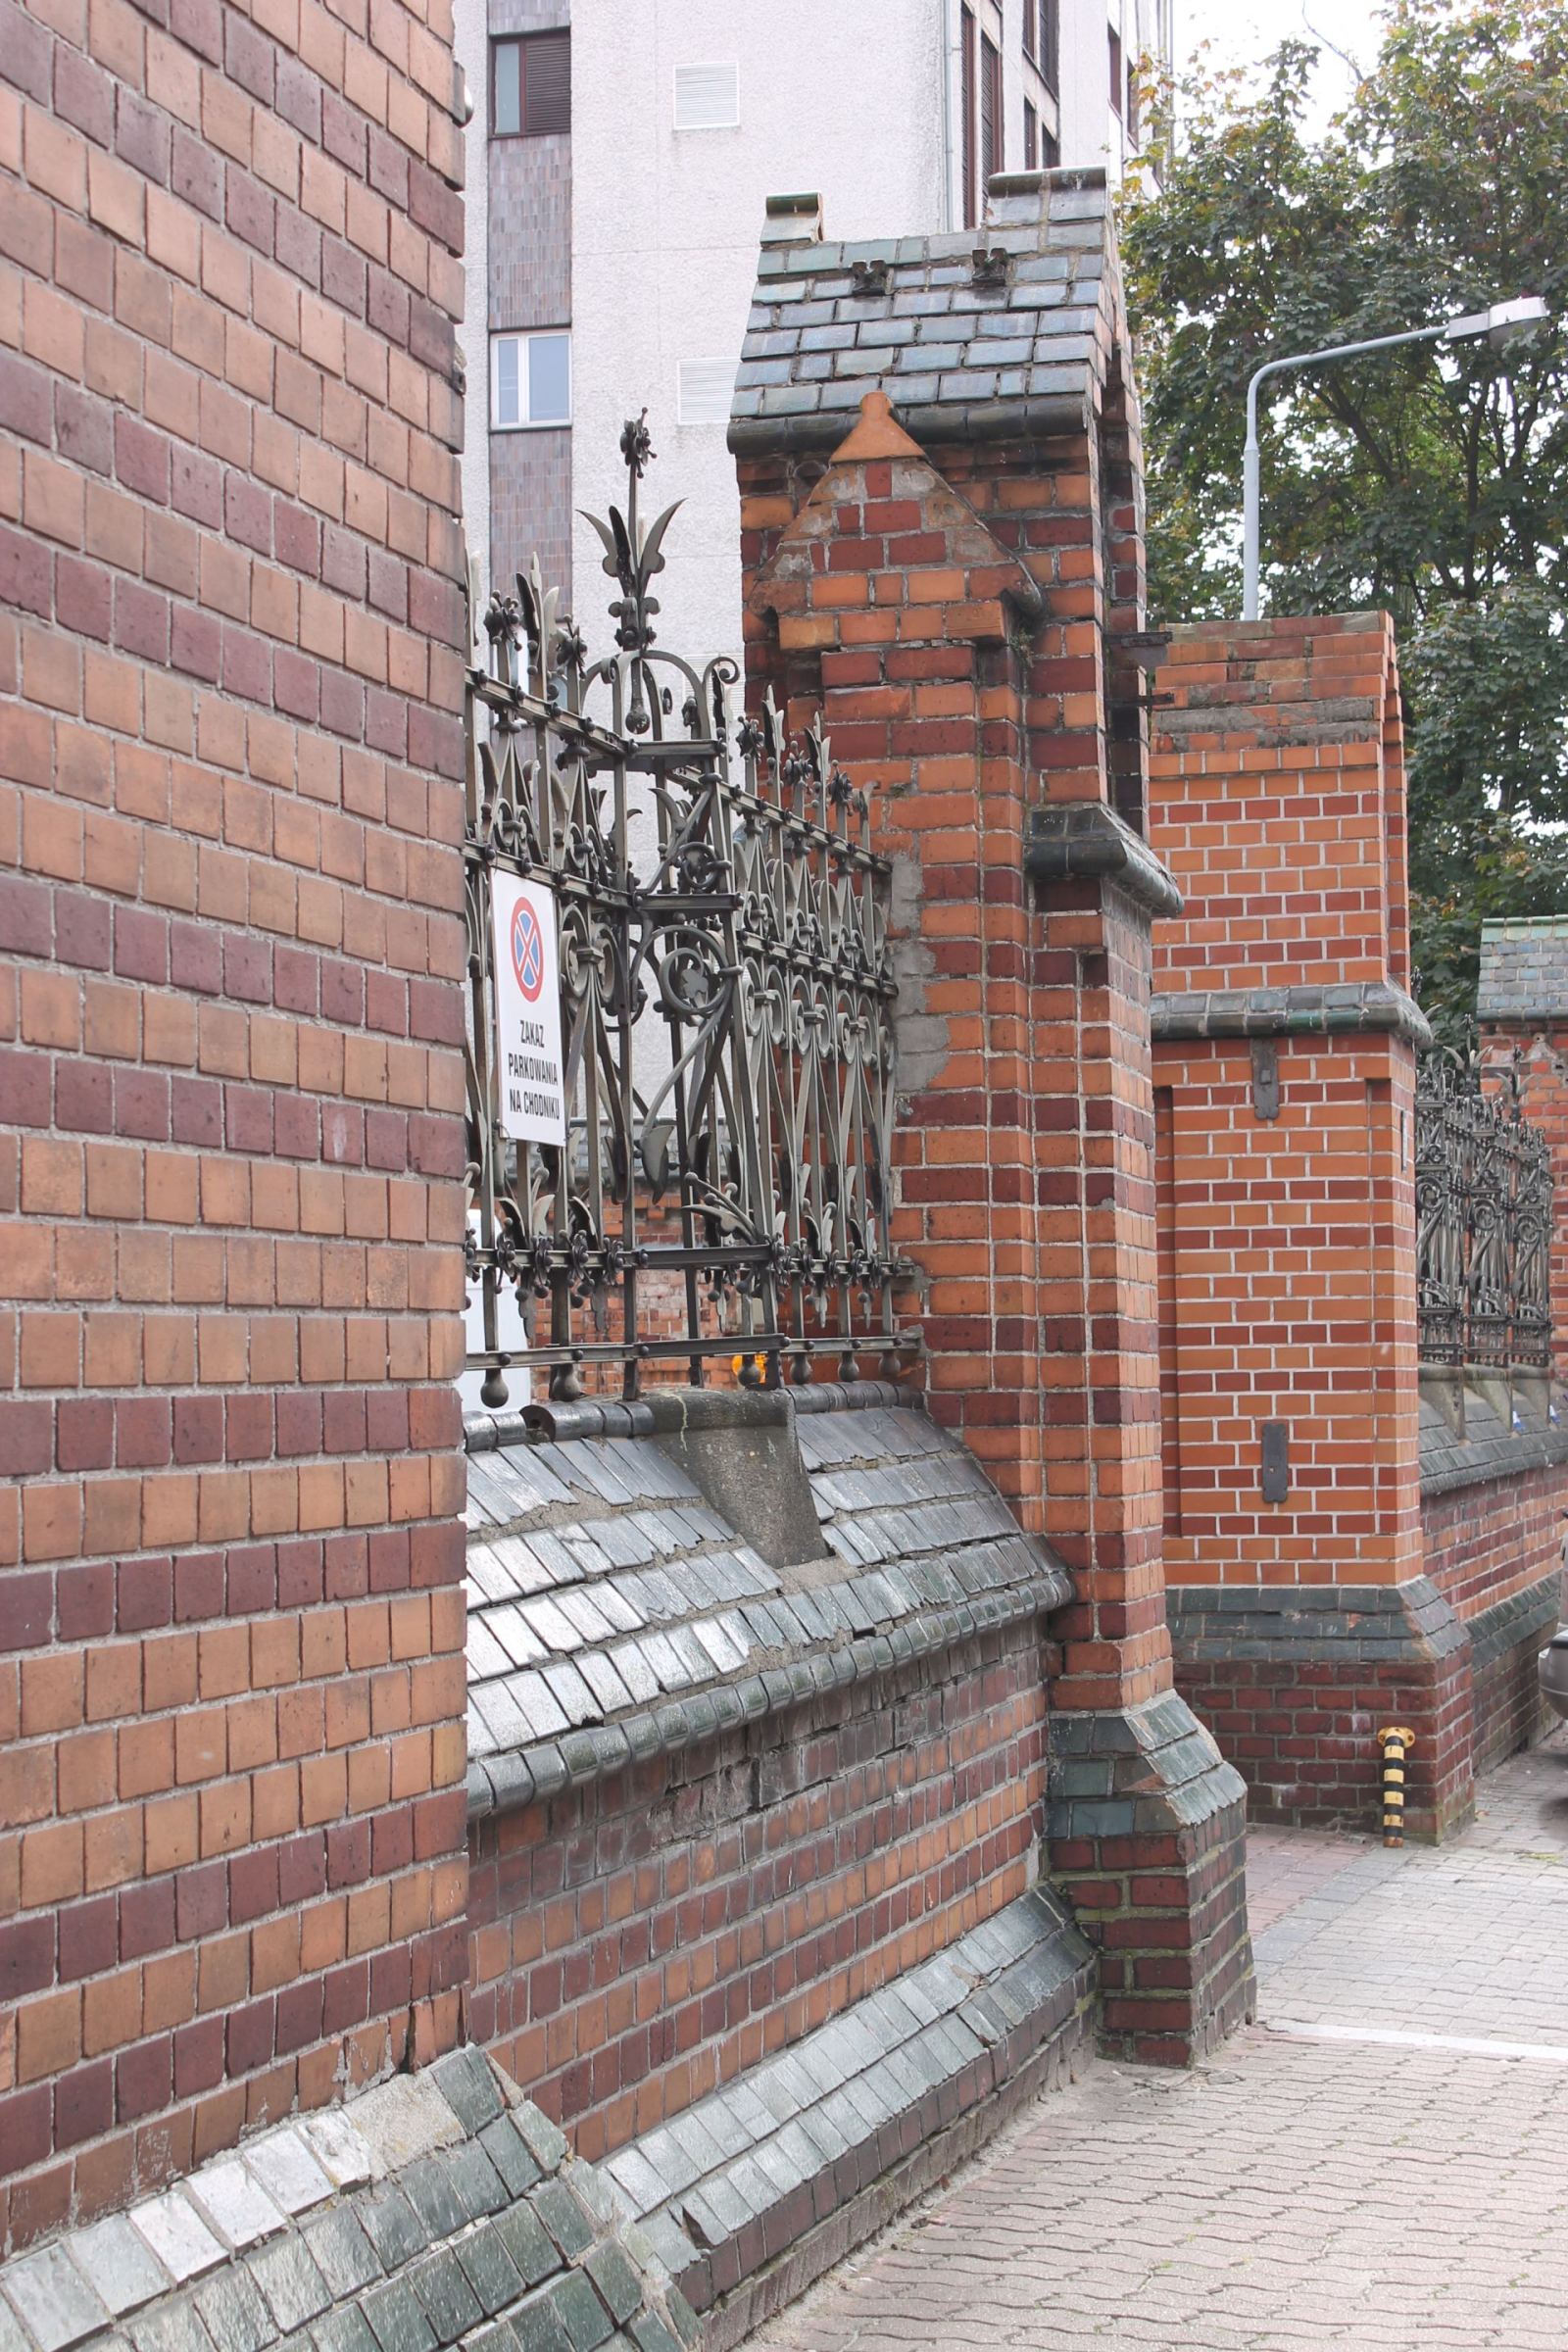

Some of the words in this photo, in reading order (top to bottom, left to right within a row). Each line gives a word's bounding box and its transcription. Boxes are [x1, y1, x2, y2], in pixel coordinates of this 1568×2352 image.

[519, 1020, 545, 1049] ZAKAZ
[508, 1053, 559, 1086] PARKOWANIA
[510, 1089, 522, 1113] NA
[523, 1091, 560, 1120] CHODNIKU
